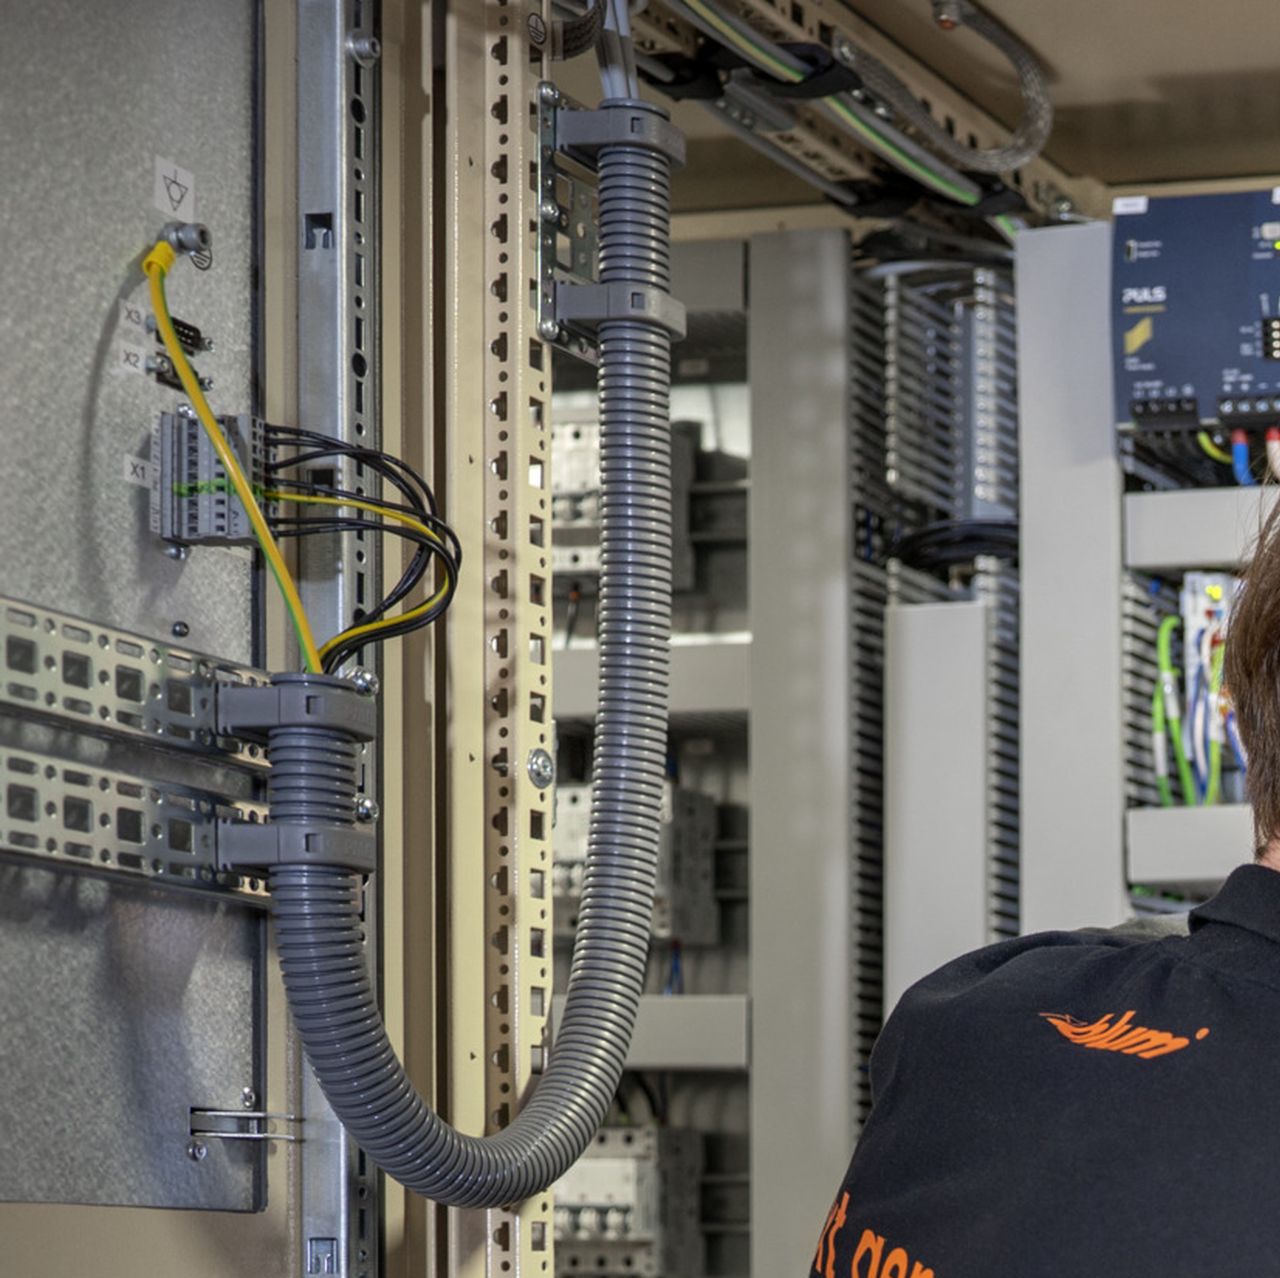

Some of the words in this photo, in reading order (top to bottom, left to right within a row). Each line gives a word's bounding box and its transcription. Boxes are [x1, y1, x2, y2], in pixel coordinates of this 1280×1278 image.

[1121, 286, 1167, 303] PULS
[125, 307, 141, 324] X3
[123, 350, 139, 368] X2
[130, 461, 146, 480] X1
